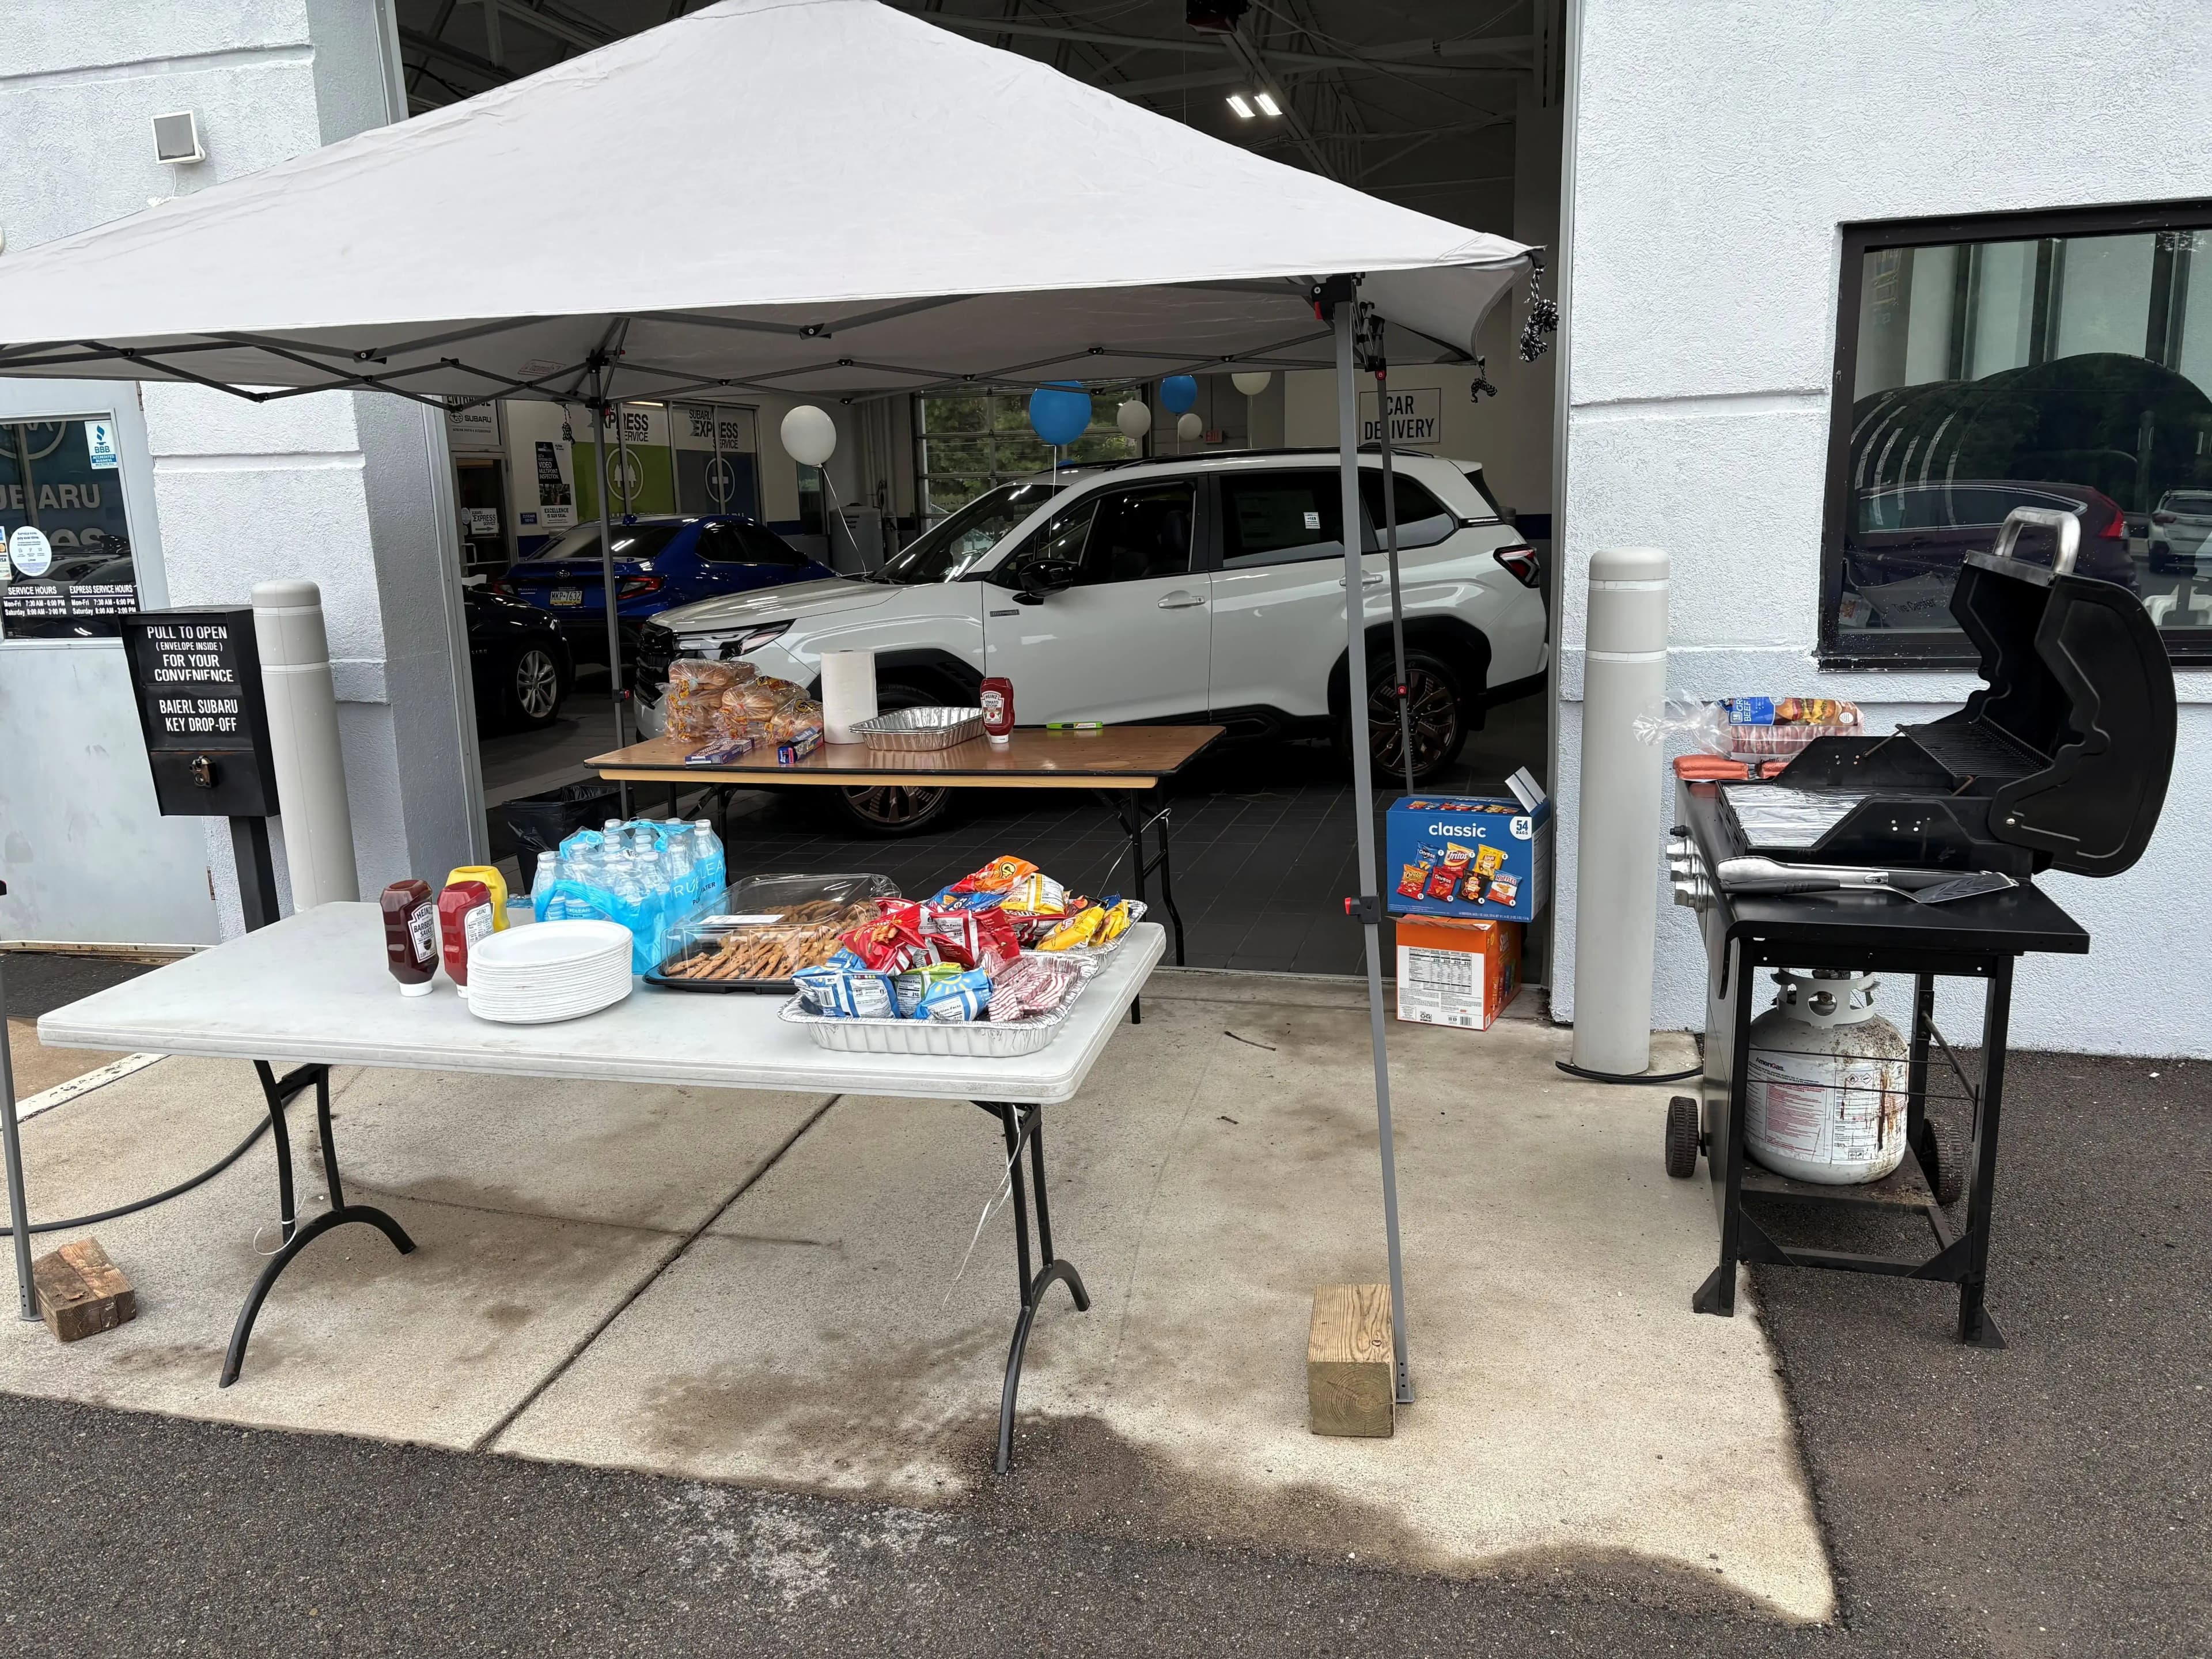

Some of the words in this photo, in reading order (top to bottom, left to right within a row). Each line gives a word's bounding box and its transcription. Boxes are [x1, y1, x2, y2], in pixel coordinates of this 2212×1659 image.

[1387, 395, 1414, 415] CAR
[464, 415, 491, 423] SUBARU
[690, 409, 712, 421] SUBARU
[690, 419, 738, 439] EXPESS
[1365, 418, 1434, 440] DEIVERY
[94, 445, 110, 453] BBB
[8, 586, 34, 595] SERVICE
[35, 586, 57, 594] HOURS
[69, 585, 92, 594] EXPRESS
[93, 585, 115, 593] SERVICE
[115, 584, 133, 593] HOURS
[3, 600, 21, 608] Mon-Fri
[1892, 603, 1907, 613] Tire
[1907, 599, 1936, 611] Center
[5, 608, 25, 617] Saturday
[73, 608, 93, 616] Saturday
[147, 626, 176, 639] PULL
[178, 626, 194, 639] TO
[196, 626, 228, 639] OPEN
[162, 654, 186, 667] FOR
[188, 654, 220, 667] YOUR
[159, 699, 196, 714] BAIERL
[197, 699, 238, 714] SUBARU
[1743, 700, 1752, 722] BEEF
[165, 717, 185, 732] KEY
[188, 717, 237, 732] DROP-OFF
[1429, 821, 1486, 838] classic
[1516, 820, 1528, 831] 54
[1419, 849, 1435, 859] Doritos
[1446, 851, 1468, 861] Fritos
[1434, 874, 1452, 884] Doritos
[1495, 874, 1517, 885] RUFFLES
[416, 906, 433, 921] HEINZ
[420, 927, 432, 937] SAUCE
